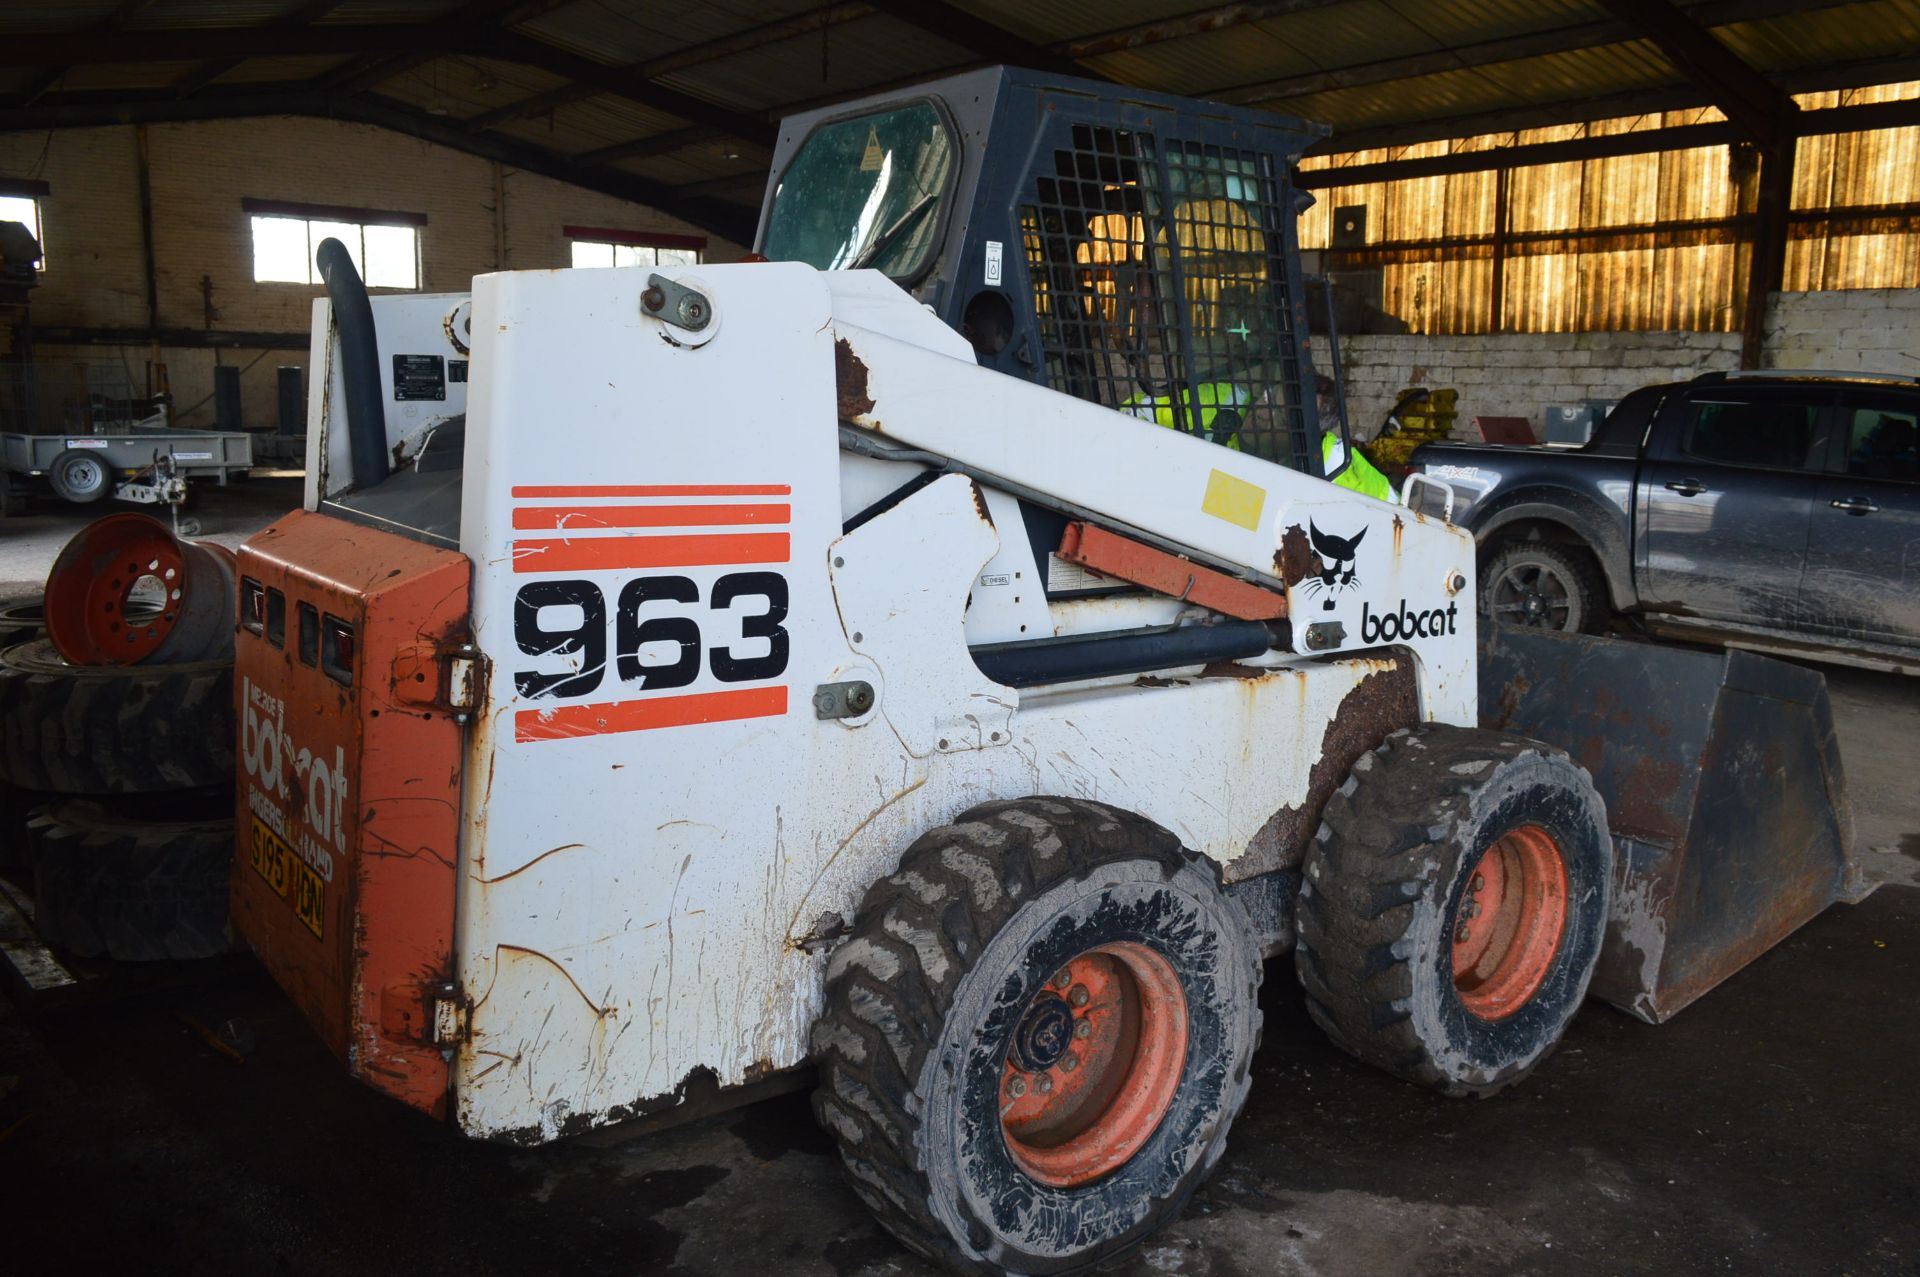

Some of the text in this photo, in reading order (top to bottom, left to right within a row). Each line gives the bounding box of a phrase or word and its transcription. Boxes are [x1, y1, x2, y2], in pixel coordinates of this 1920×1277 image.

[514, 571, 790, 700] 963
[1361, 599, 1458, 644] bobcat
[252, 825, 284, 888] S195
